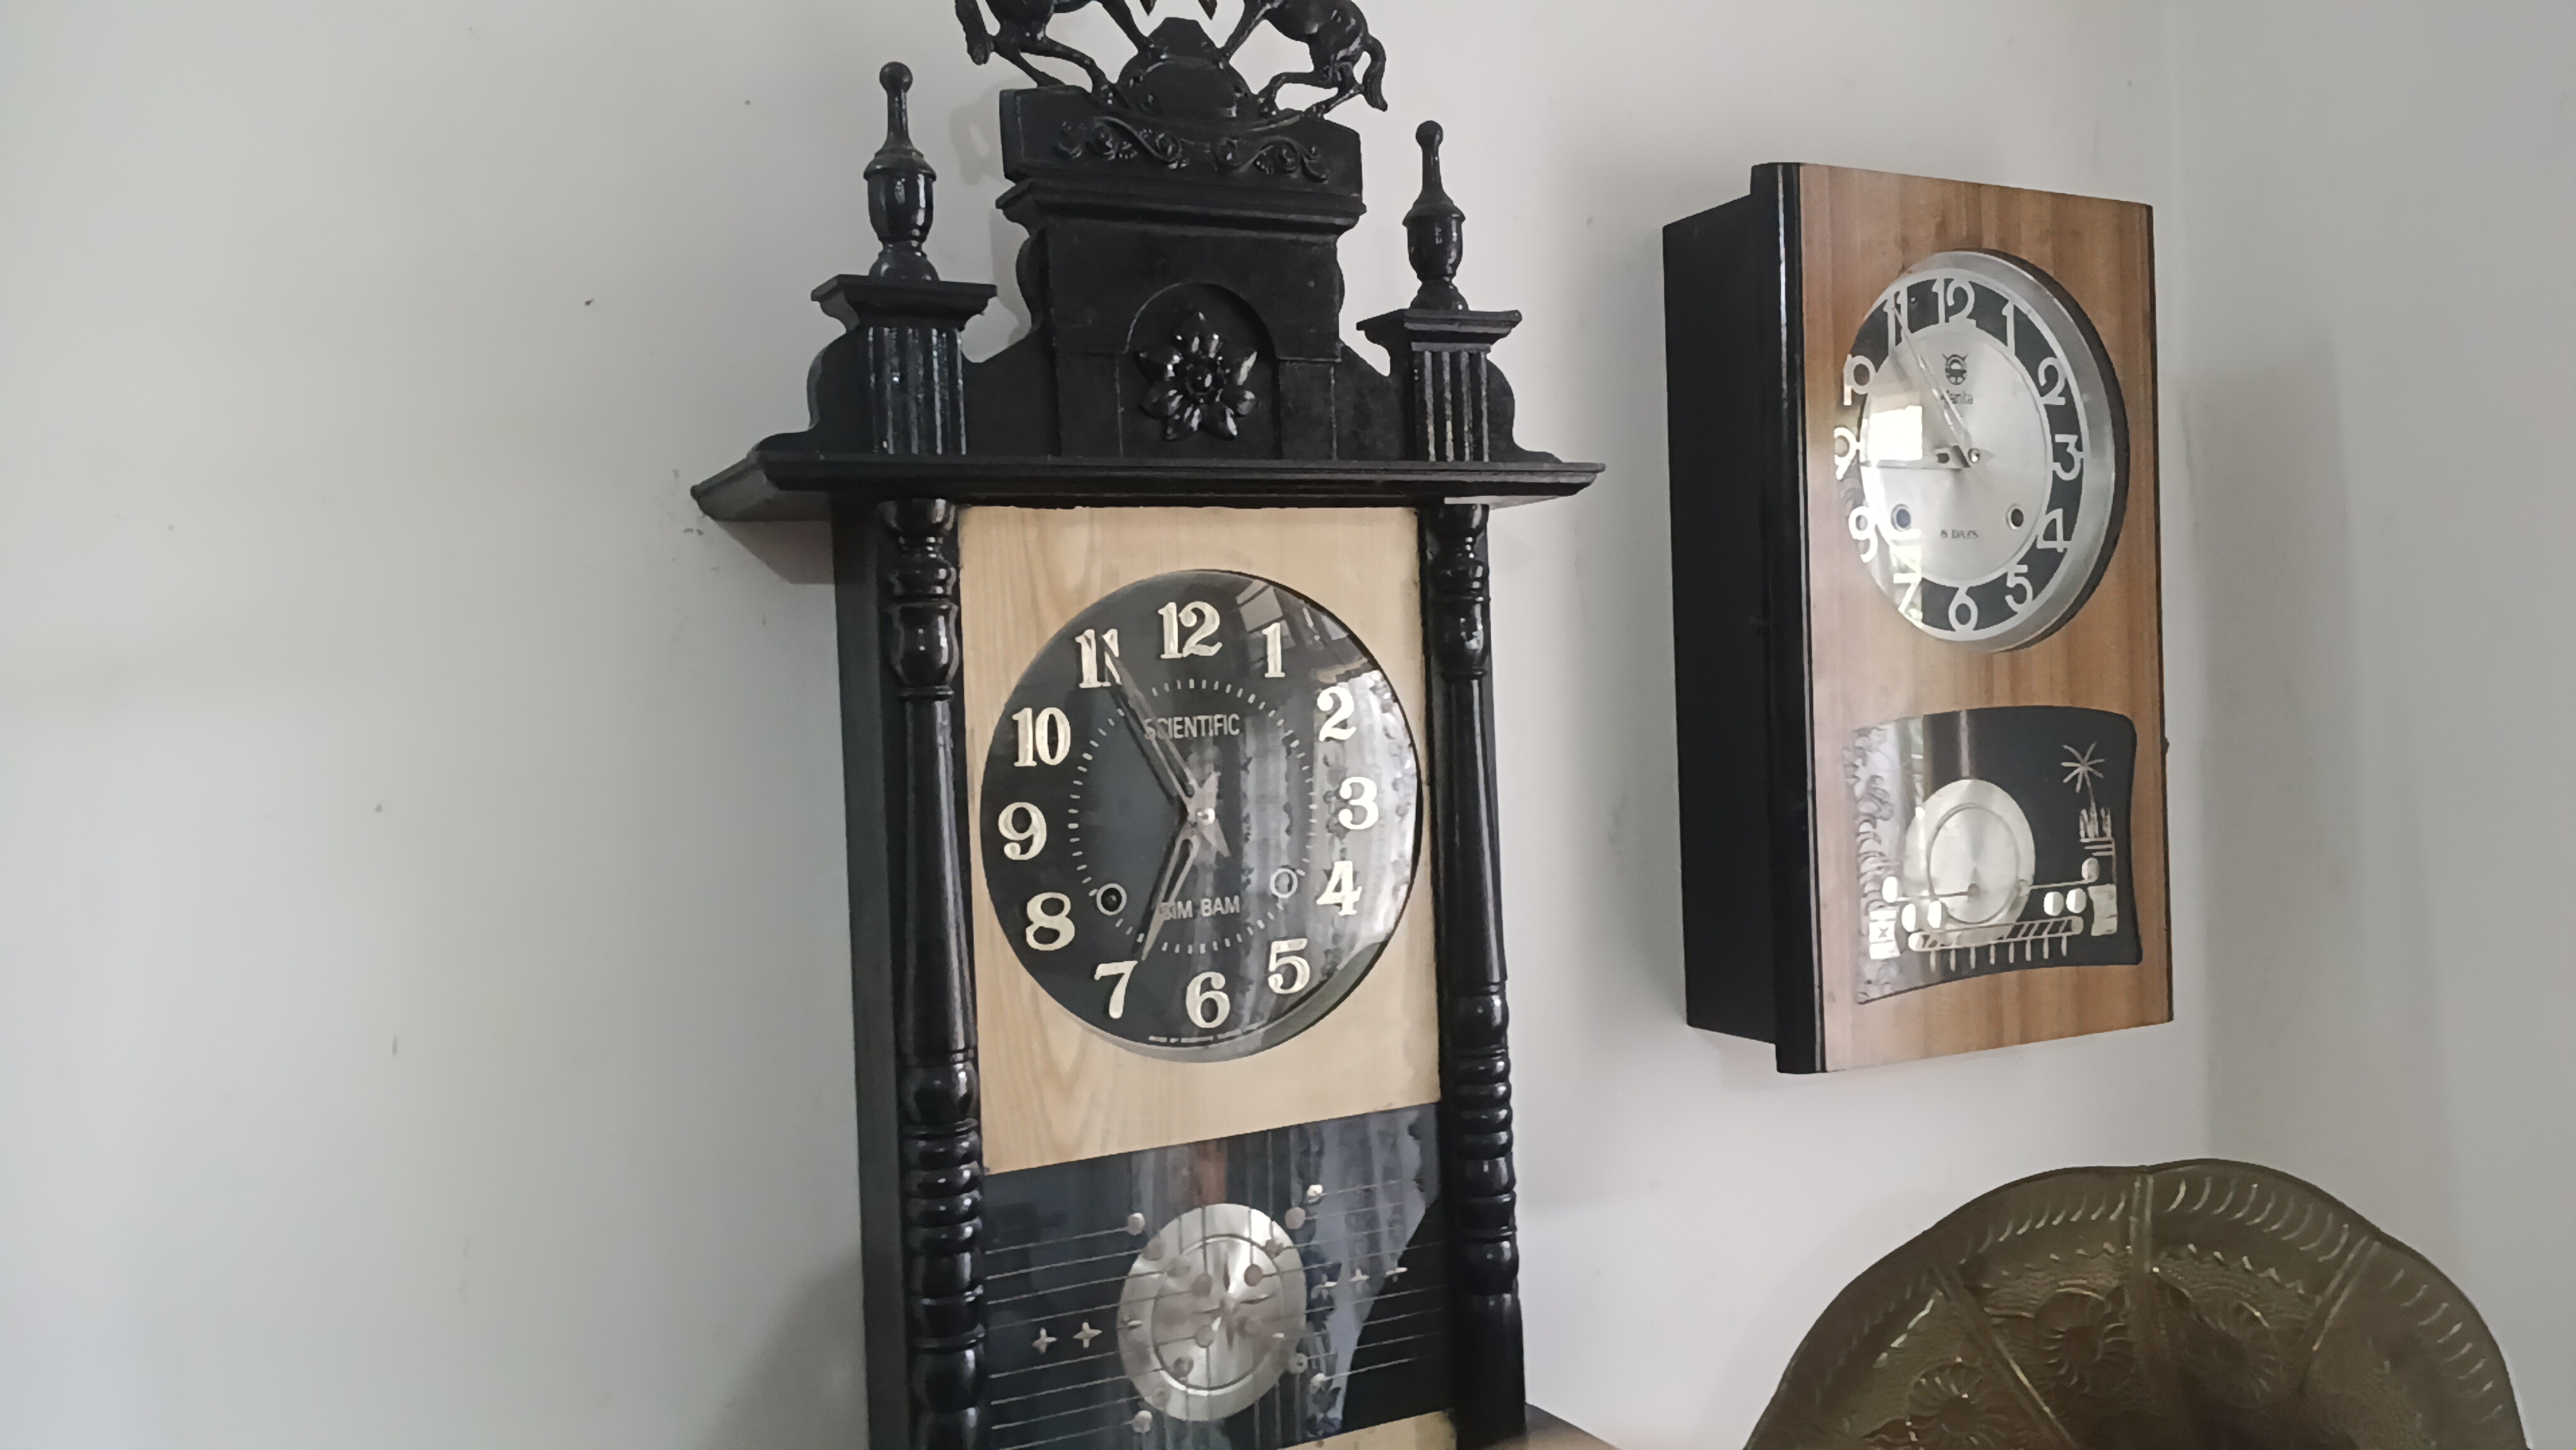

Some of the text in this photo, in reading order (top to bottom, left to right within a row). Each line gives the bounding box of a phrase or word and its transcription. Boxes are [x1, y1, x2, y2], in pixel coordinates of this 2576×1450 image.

[1883, 284, 1908, 347] 11
[1932, 278, 1976, 328] 12
[2001, 297, 2016, 355] 1
[2037, 357, 2066, 405] 2
[2053, 434, 2084, 481] 3
[2036, 508, 2072, 553] 4
[1948, 587, 1977, 632] 6
[2005, 564, 2033, 613] 5
[1158, 601, 1222, 659] 12
[1262, 622, 1286, 678] 1
[1075, 628, 1123, 688] 11
[1012, 707, 1071, 767] 10
[1143, 713, 1240, 740] SCIENTIFIC
[1316, 686, 1357, 741] 2
[1339, 776, 1379, 830] 3
[998, 802, 1047, 861] 9
[1158, 895, 1240, 921] IM BAM
[1316, 861, 1363, 916] 4
[1025, 892, 1075, 950] 8
[1094, 960, 1138, 1019] 7
[1268, 938, 1310, 995] 5
[1186, 971, 1231, 1028] 6
